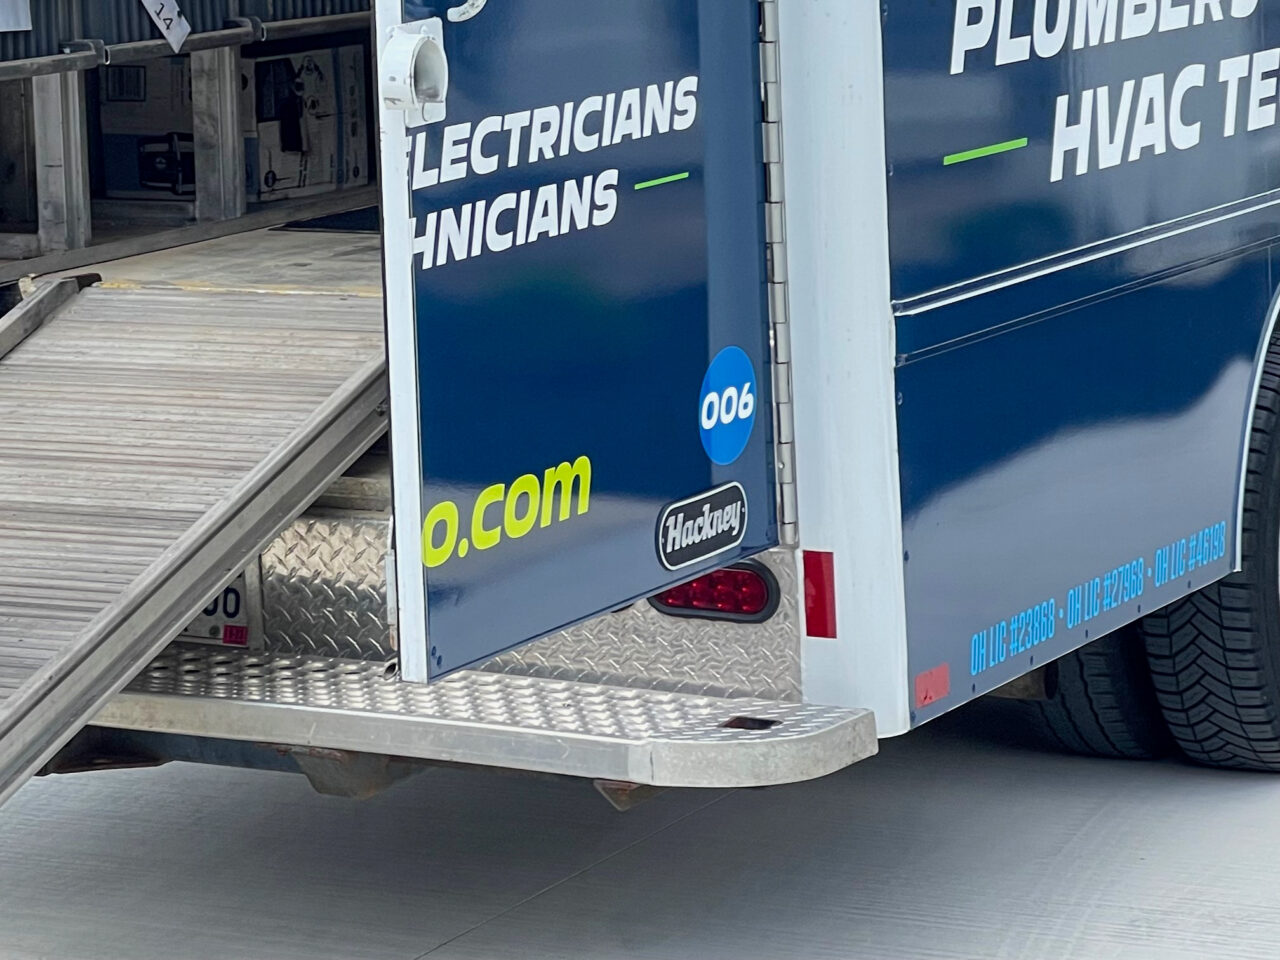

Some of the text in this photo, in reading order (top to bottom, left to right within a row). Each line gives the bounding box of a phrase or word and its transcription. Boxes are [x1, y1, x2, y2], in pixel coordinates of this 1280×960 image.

[154, 2, 174, 31] 14
[406, 76, 698, 190] LECTRICIANS
[1050, 64, 1206, 182] HVAC
[701, 382, 754, 430] 006
[422, 455, 592, 568] o.com
[666, 501, 741, 553] Hackney
[971, 630, 986, 675] OH
[990, 621, 1006, 667] LIC
[1010, 598, 1055, 656] #23868
[1067, 588, 1082, 629] OH
[1085, 577, 1100, 621] LIC
[1103, 556, 1144, 612] #27968
[1155, 548, 1169, 587] OH
[1171, 538, 1186, 580] LIC
